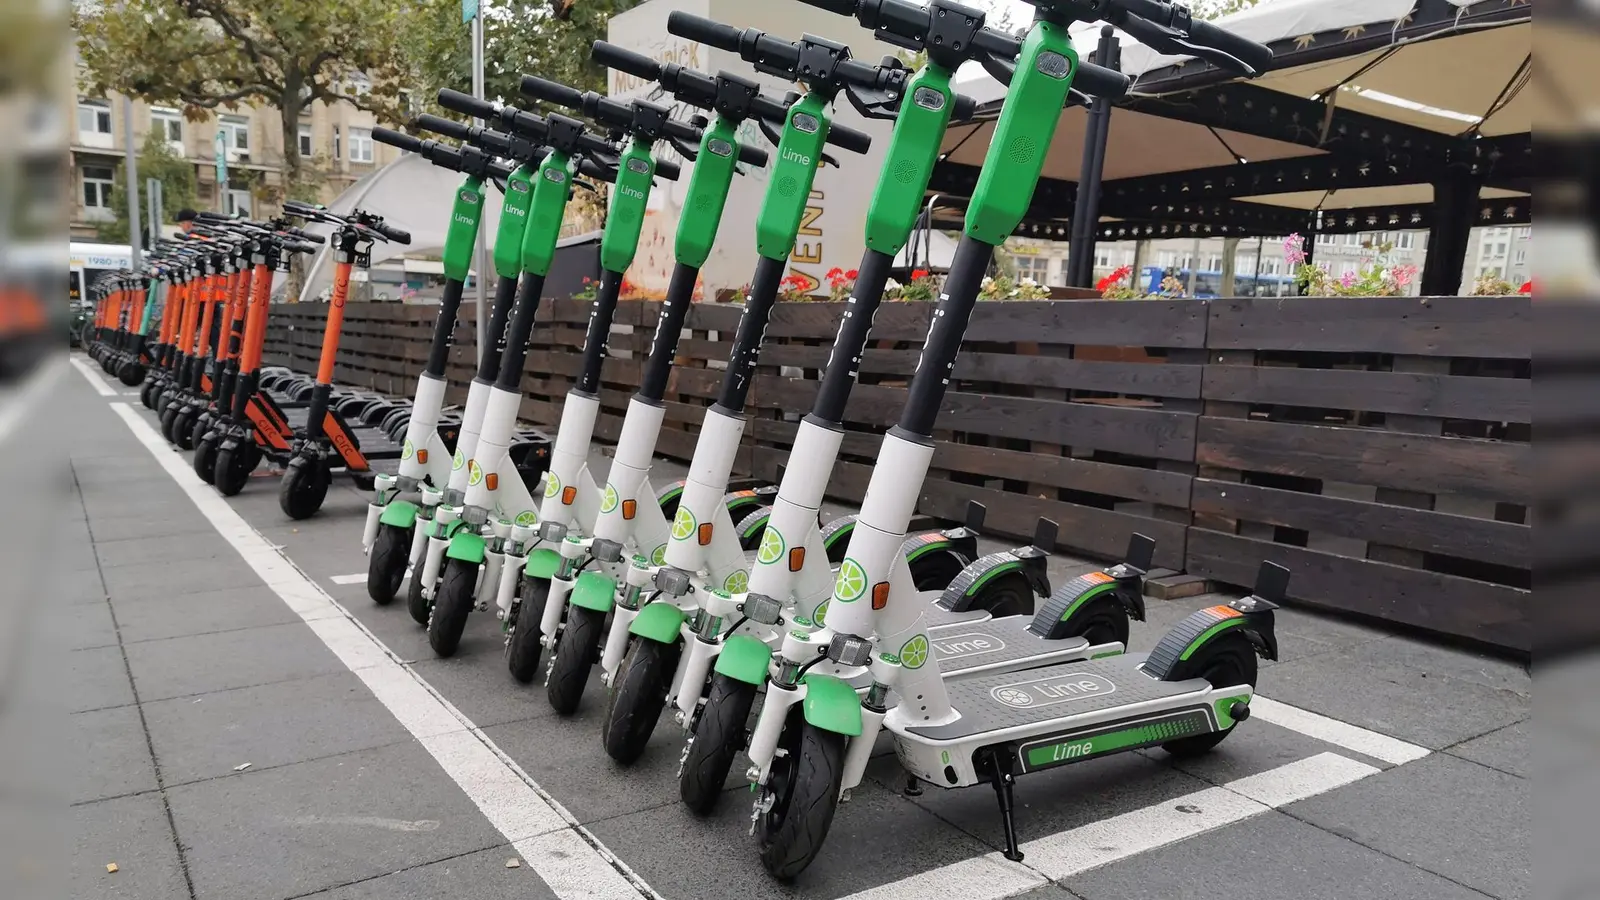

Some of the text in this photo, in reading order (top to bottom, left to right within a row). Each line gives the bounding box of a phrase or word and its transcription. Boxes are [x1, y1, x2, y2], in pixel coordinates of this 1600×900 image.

[782, 147, 810, 165] Lime
[620, 184, 644, 199] Lime
[454, 212, 474, 226] Lime
[505, 203, 525, 217] Lime
[335, 278, 348, 308] circ
[258, 419, 277, 438] circ
[334, 434, 353, 457] circ
[932, 638, 992, 655] Lime
[1033, 680, 1100, 698] Lime
[1053, 742, 1093, 761] Lime
